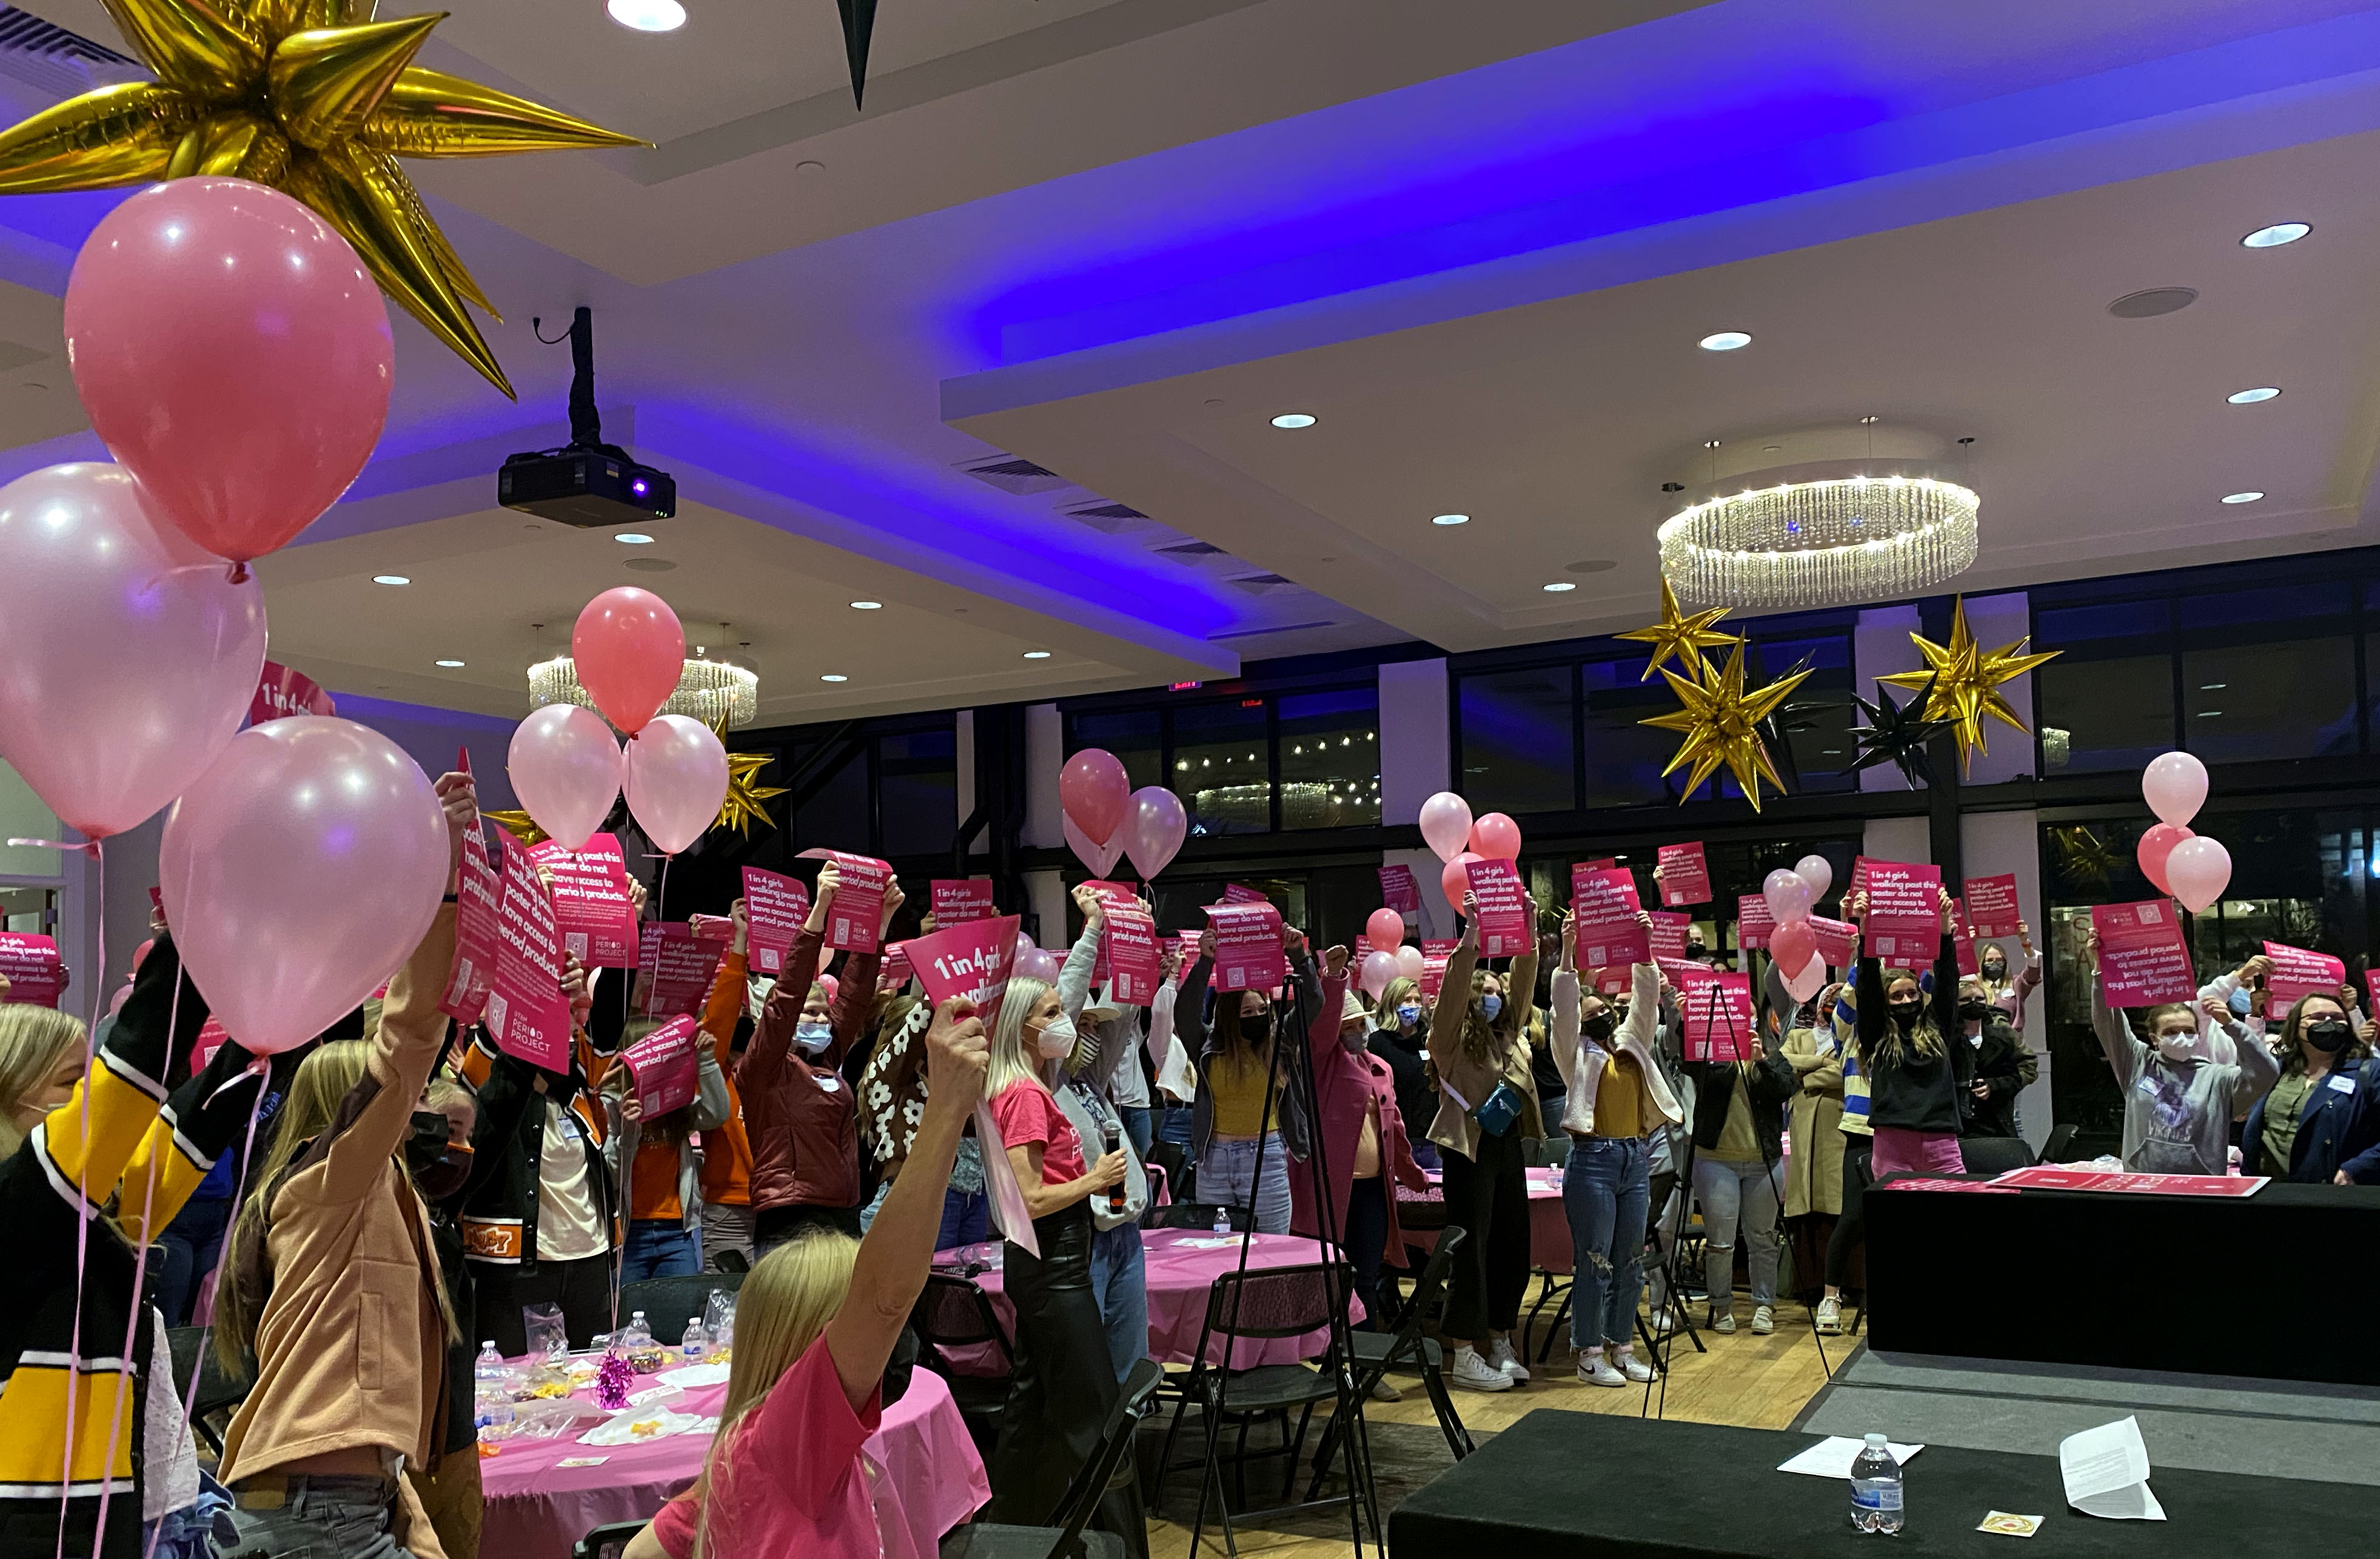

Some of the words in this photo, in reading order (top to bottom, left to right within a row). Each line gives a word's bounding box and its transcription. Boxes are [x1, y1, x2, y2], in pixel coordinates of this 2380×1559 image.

[262, 683, 271, 705] 1
[273, 685, 287, 711] in
[289, 692, 297, 716] 4
[506, 842, 512, 856] 1
[518, 856, 525, 870] 4
[585, 852, 605, 863] past
[604, 850, 621, 863] this
[579, 861, 592, 873] do
[592, 864, 609, 874] not
[876, 868, 883, 879] to
[1476, 868, 1484, 876] in
[1484, 867, 1491, 875] 4
[1490, 865, 1504, 877] girls
[748, 873, 753, 882] 1
[753, 874, 761, 884] in
[761, 876, 767, 885] 4
[768, 877, 784, 889] girls
[1473, 877, 1501, 885] walking
[1501, 876, 1513, 885] past
[1891, 871, 1909, 881] girls
[507, 863, 538, 909] walking
[603, 877, 614, 888] to
[1595, 877, 1610, 889] girls
[1871, 880, 1904, 890] walking
[1923, 880, 1937, 890] this
[586, 890, 627, 902] products.
[749, 885, 780, 899] walking
[780, 891, 797, 900] past
[942, 888, 950, 897] in
[950, 888, 956, 897] 4
[956, 888, 971, 899] girls
[1476, 887, 1497, 896] poster
[1497, 885, 1506, 893] do
[1578, 888, 1607, 899] walking
[1607, 886, 1623, 896] past
[1622, 883, 1634, 892] this
[505, 882, 532, 913] poster
[531, 904, 542, 922] do
[542, 916, 555, 935] not
[750, 895, 775, 905] poster
[775, 899, 786, 907] do
[786, 902, 799, 911] not
[937, 899, 966, 910] walking
[965, 900, 981, 908] past
[1480, 904, 1500, 914] period
[1578, 899, 1601, 908] poster
[751, 902, 771, 914] have
[771, 908, 794, 919] access
[794, 912, 802, 921] to
[937, 910, 959, 919] poster
[959, 909, 968, 917] do
[1871, 907, 1897, 916] period
[1897, 907, 1935, 917] products.
[501, 896, 523, 927] have
[523, 919, 548, 948] access
[548, 939, 557, 955] to
[751, 914, 777, 925] period
[1109, 916, 1124, 928] have
[1123, 921, 1140, 931] access
[1139, 922, 1147, 932] to
[1216, 917, 1239, 925] poster
[1580, 915, 1605, 928] period
[1217, 925, 1237, 934] have
[1111, 930, 1130, 942] period
[1129, 932, 1153, 945] products.
[1217, 934, 1242, 945] period
[1243, 932, 1278, 944] products.
[595, 948, 626, 957] PROJECT
[2105, 946, 2149, 960] products.
[2150, 942, 2181, 957] period
[523, 944, 560, 981] products.
[934, 957, 951, 980] 1
[947, 954, 974, 976] in
[973, 947, 985, 971] 4
[985, 944, 1001, 977] girls
[2117, 961, 2128, 970] to
[2129, 958, 2158, 967] access
[2159, 954, 2184, 965] have
[2123, 971, 2139, 979] not
[2140, 968, 2154, 979] do
[2154, 965, 2185, 974] poster
[2126, 978, 2147, 989] past
[2148, 974, 2189, 987] walking
[2270, 973, 2298, 982] period
[2298, 976, 2339, 985] products.
[2107, 982, 2125, 991] this
[2144, 987, 2165, 998] girls
[2165, 987, 2173, 996] 4
[2174, 986, 2185, 994] in
[511, 1029, 551, 1053] PROJECT
[651, 1034, 665, 1043] do
[664, 1027, 681, 1038] not
[627, 1048, 652, 1060] have
[652, 1039, 679, 1053] access
[677, 1036, 686, 1045] to
[634, 1053, 662, 1071] period
